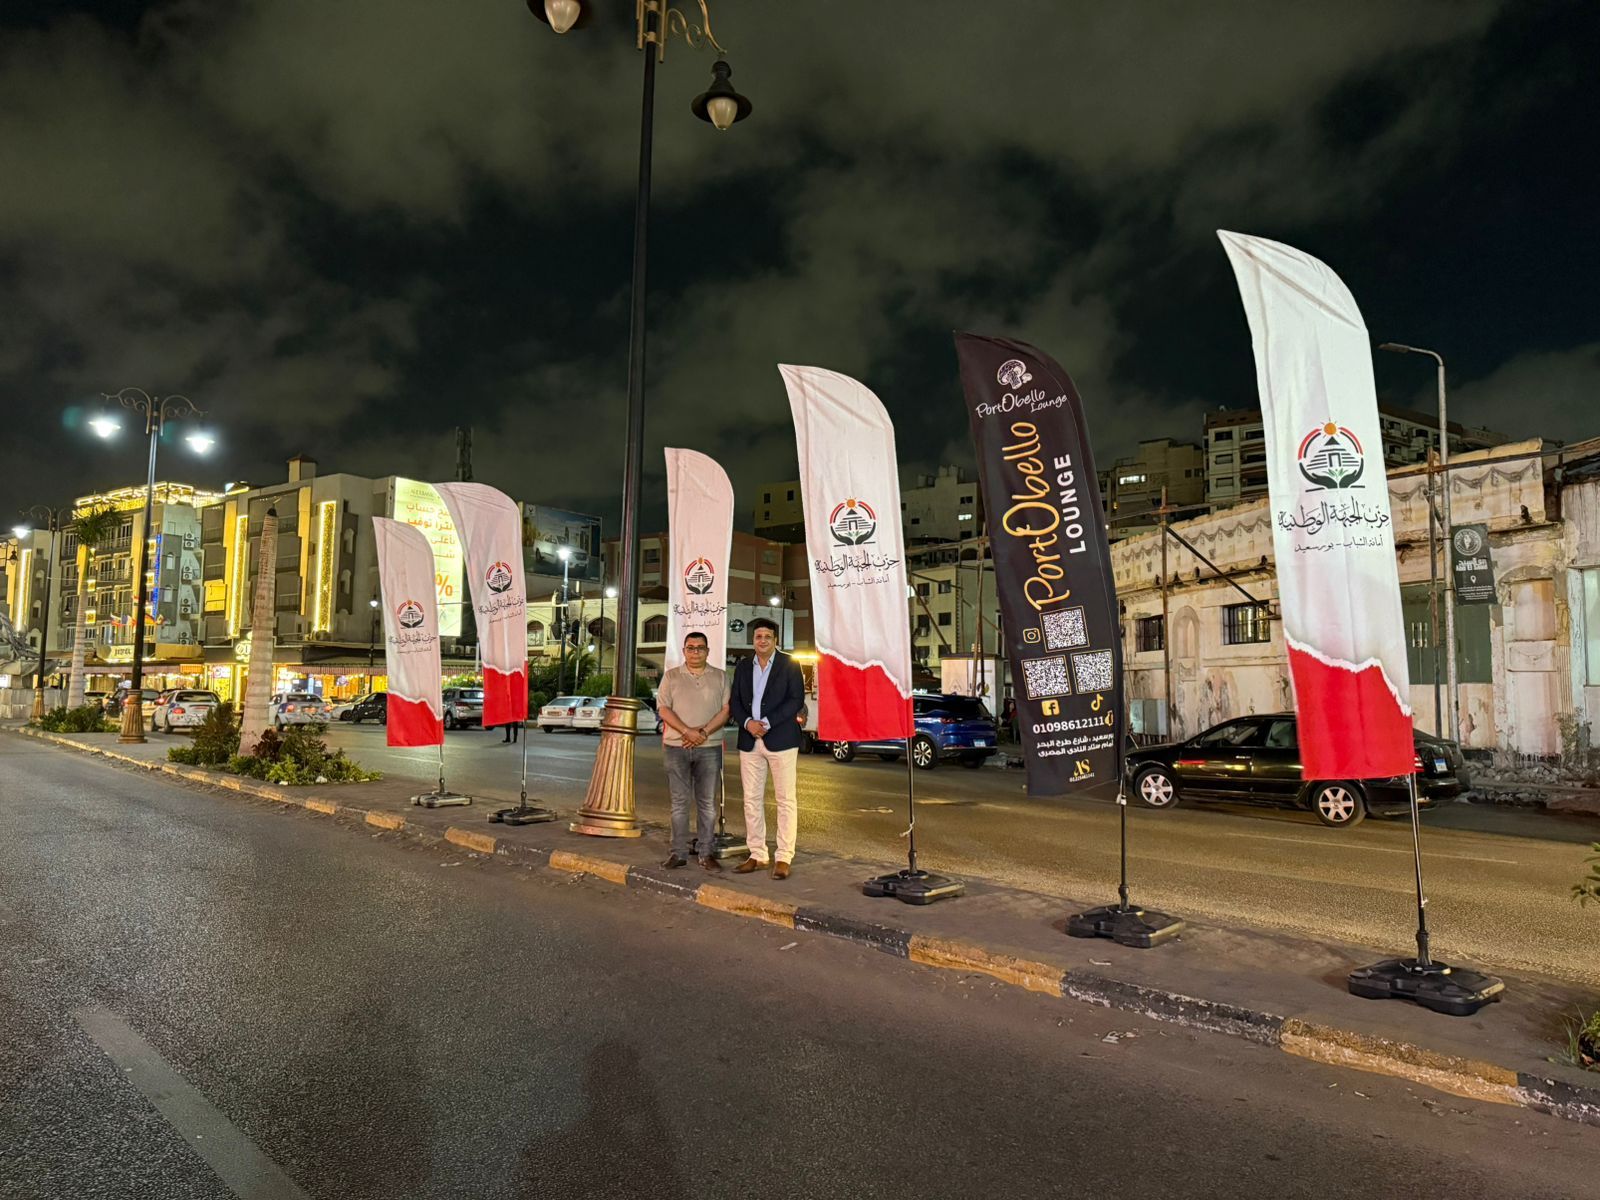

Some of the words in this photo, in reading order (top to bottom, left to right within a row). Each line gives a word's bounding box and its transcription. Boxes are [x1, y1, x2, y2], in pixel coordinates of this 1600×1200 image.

[976, 388, 1046, 418] PortObello
[1030, 393, 1068, 413] Lounge
[1002, 421, 1071, 611] PortObello
[1053, 453, 1087, 554] LOUNGE
[1032, 716, 1105, 734] 01098612111
